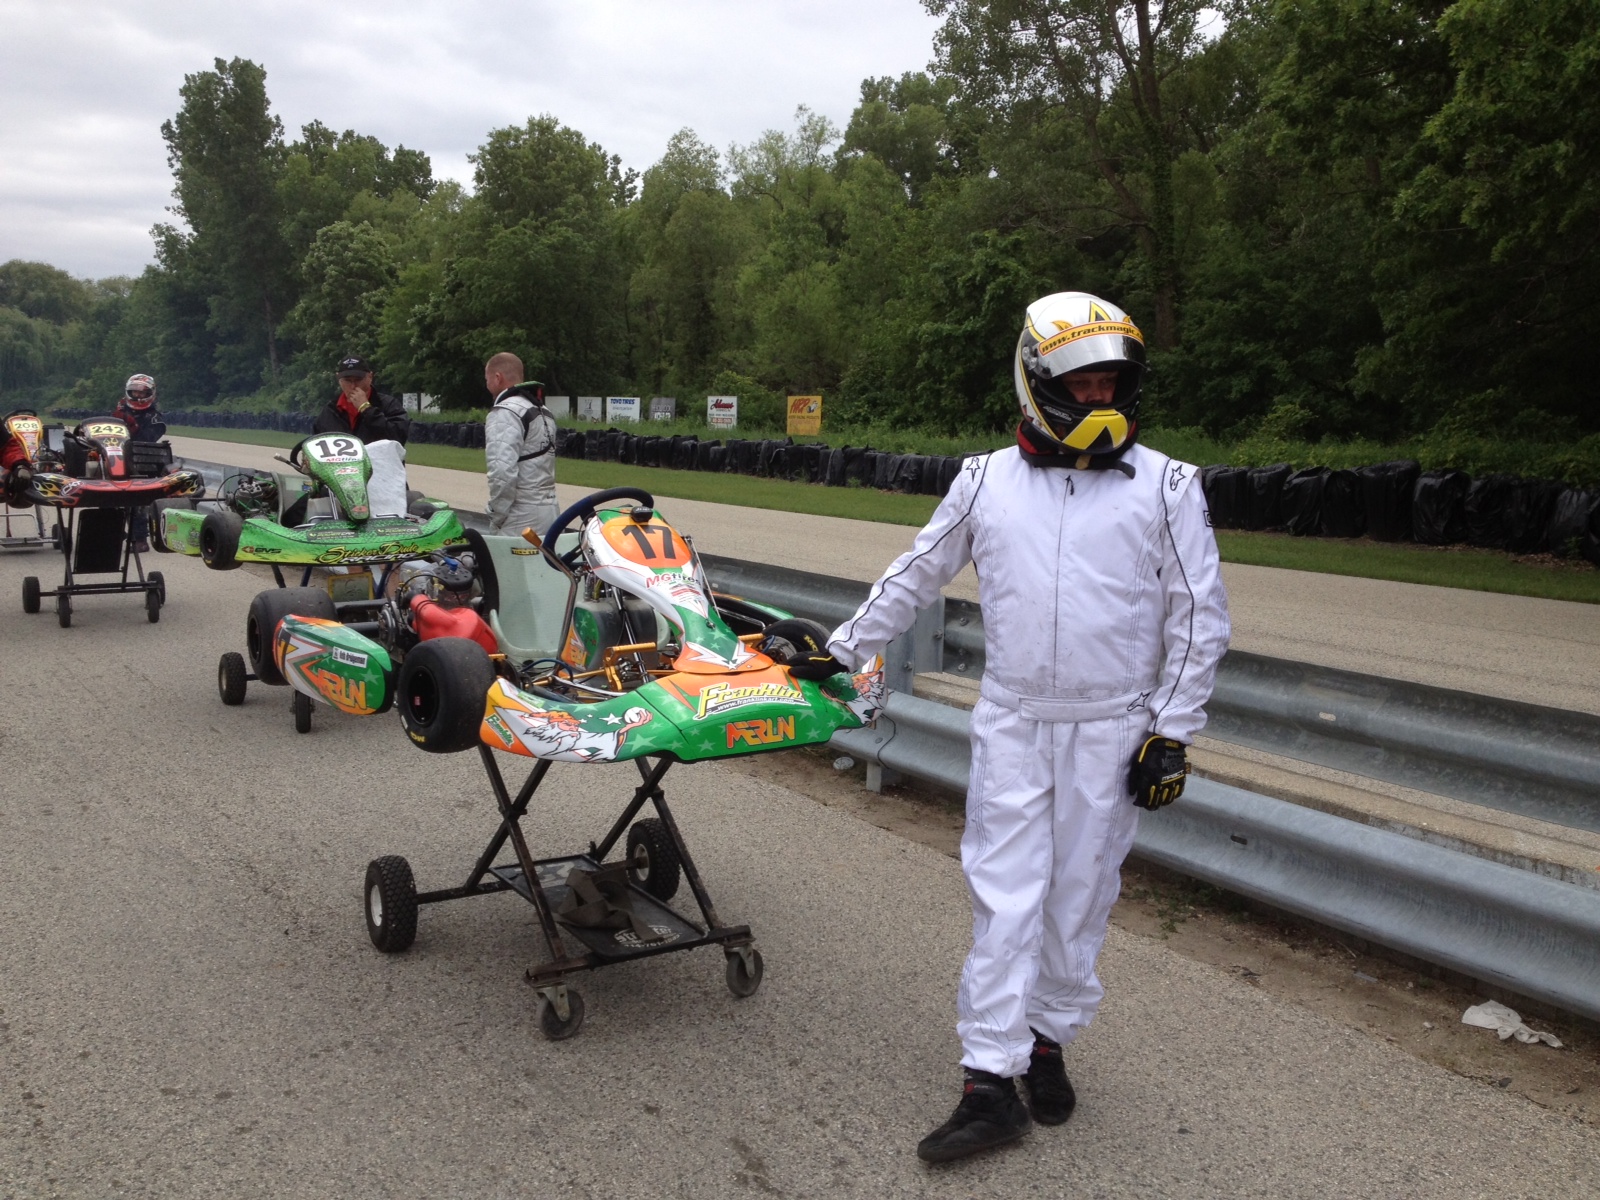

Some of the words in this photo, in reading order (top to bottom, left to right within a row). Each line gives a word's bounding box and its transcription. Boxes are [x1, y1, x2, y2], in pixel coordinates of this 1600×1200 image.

[14, 422, 39, 430] 208
[92, 425, 124, 434] 242
[315, 439, 358, 458] 12
[622, 525, 676, 560] 17
[697, 682, 802, 719] Franklin
[726, 715, 795, 748] MERLIN
